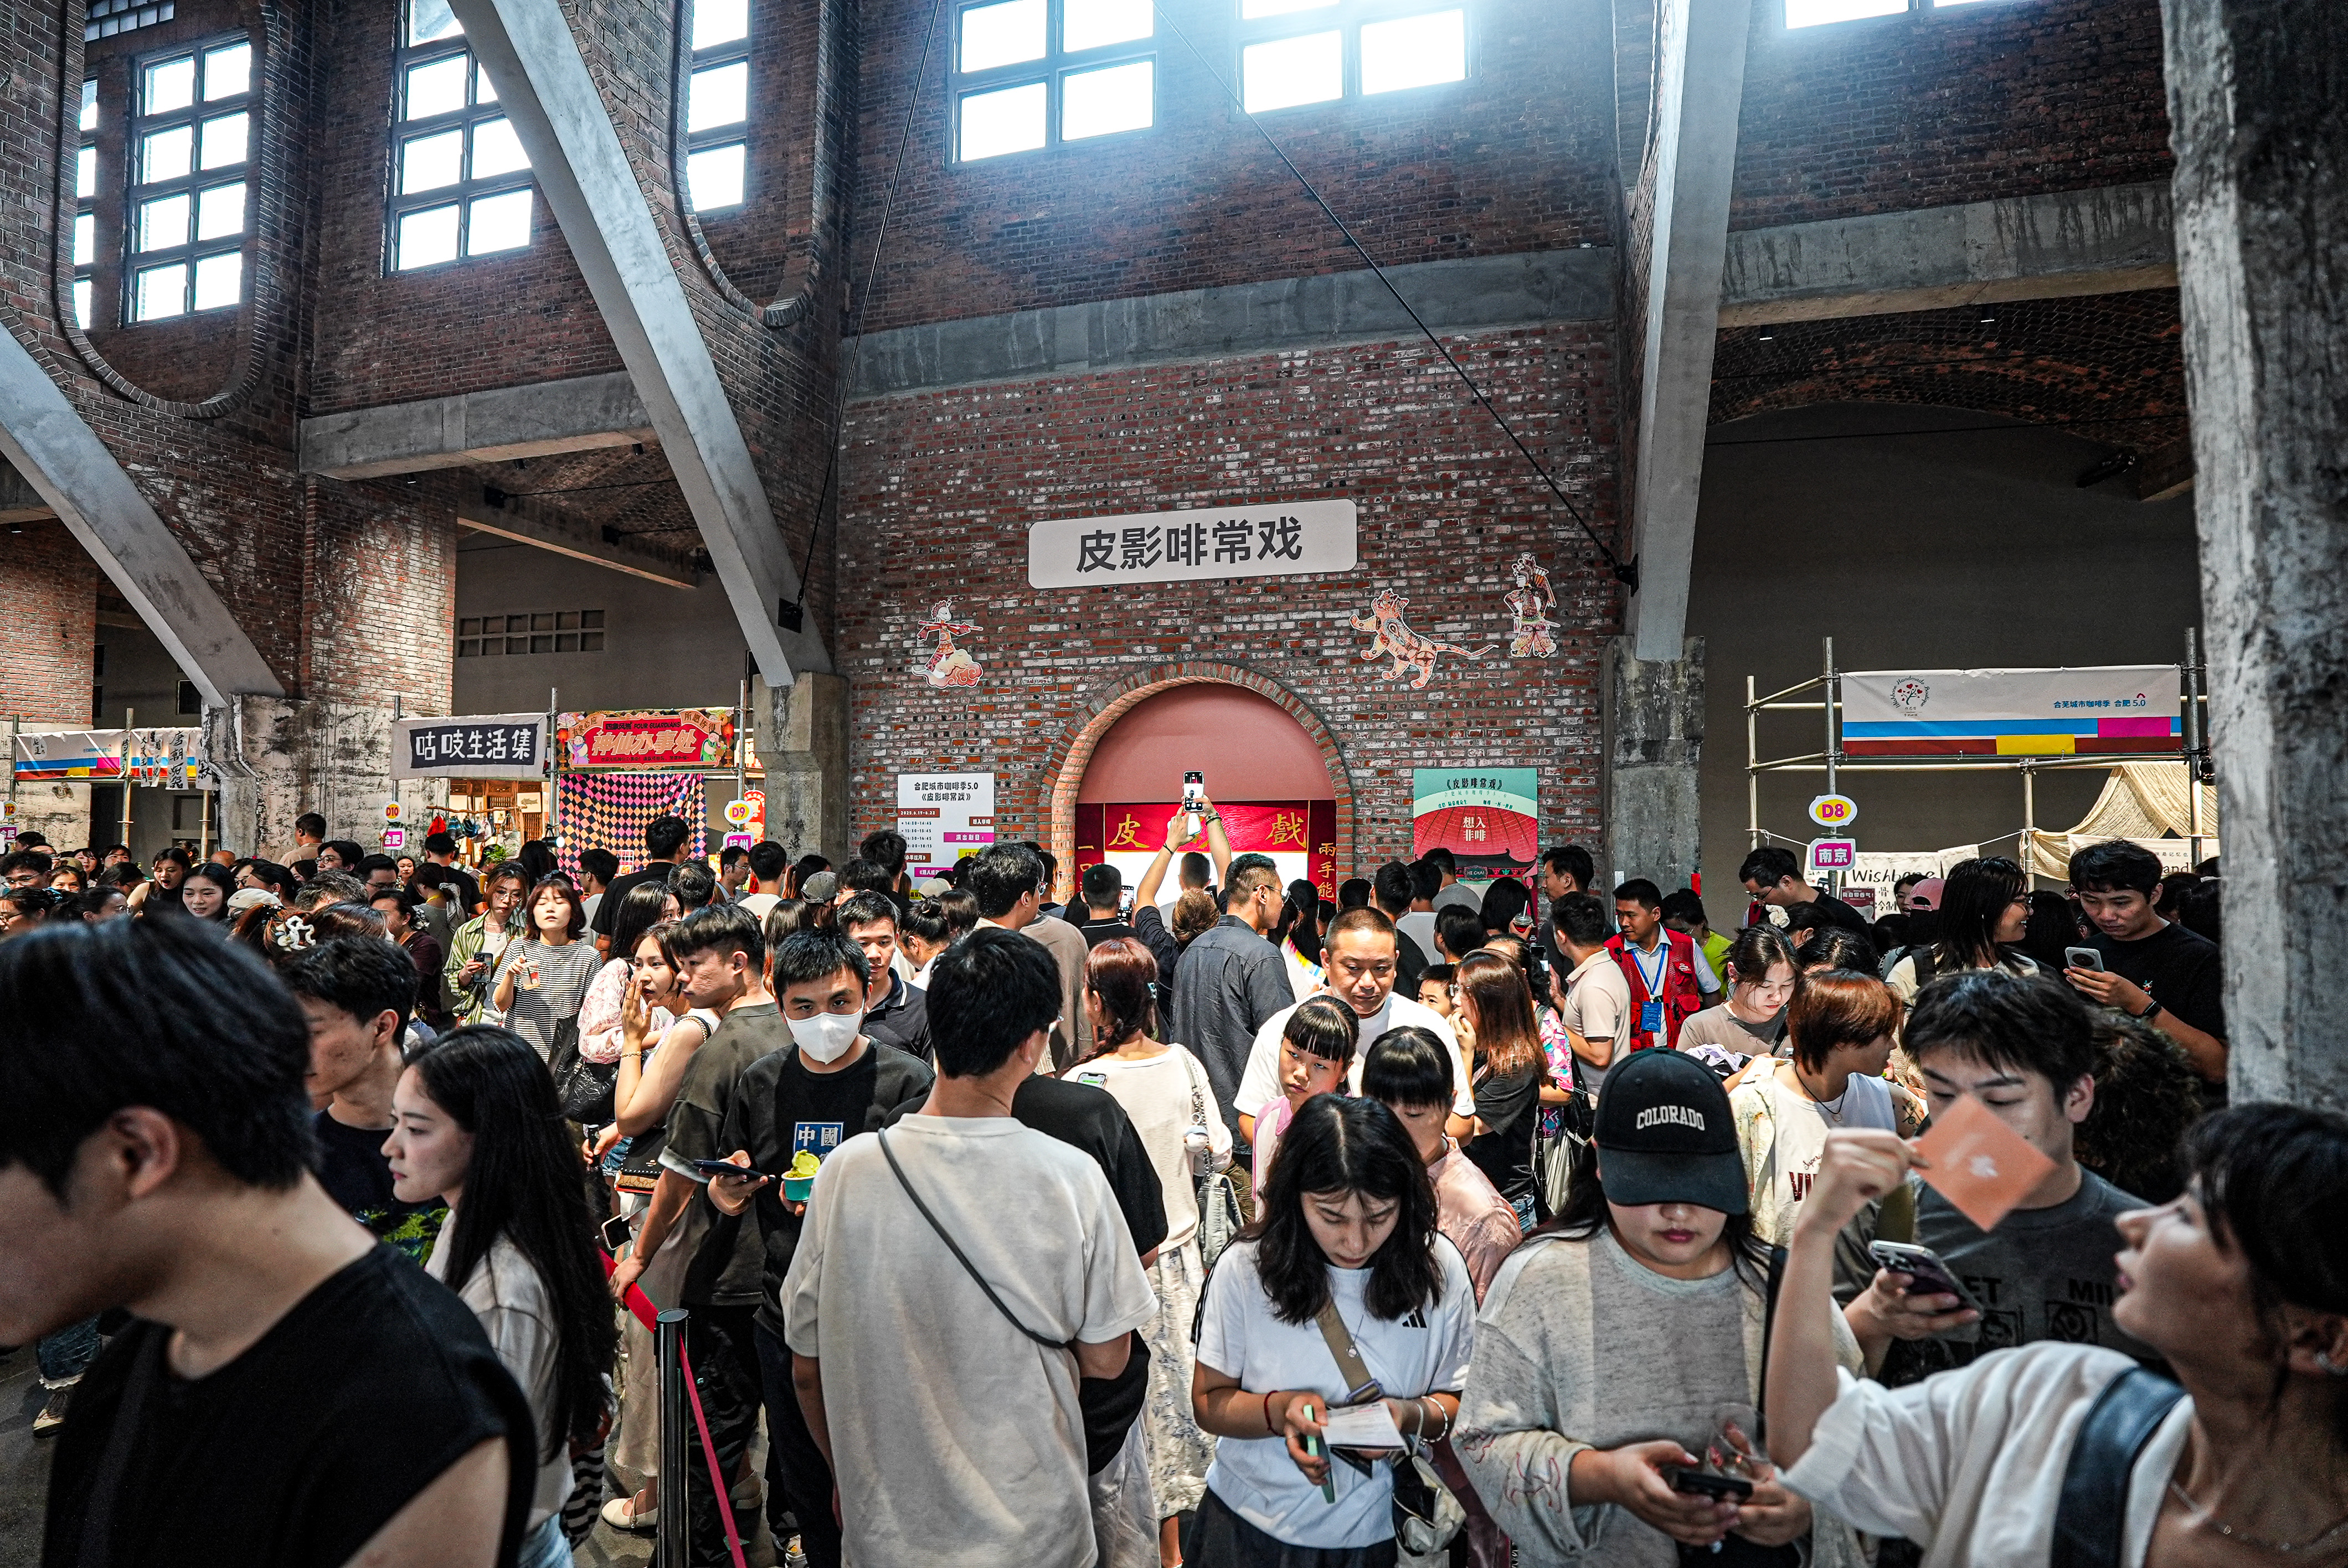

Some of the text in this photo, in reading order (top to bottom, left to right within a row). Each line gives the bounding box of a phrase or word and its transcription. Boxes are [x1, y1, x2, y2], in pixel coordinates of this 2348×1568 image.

[1076, 516, 1302, 573] 皮影啡常戏
[2053, 700, 2110, 708] 合芜城市咖啡季
[416, 728, 532, 761] 咕吱生活集
[592, 729, 697, 756] 神仙办事处
[914, 781, 979, 791] 合肥城市咖啡季5.0
[922, 793, 971, 801] 《皮影啡常戏》
[386, 807, 399, 817] D10
[732, 807, 745, 818] D9
[1822, 803, 1844, 818] D8
[1463, 816, 1486, 828] 想入
[384, 834, 401, 844] 合肥
[1819, 848, 1847, 863] 南京
[1318, 843, 1336, 898] 兩手能
[1636, 1105, 1705, 1131] COLORADO
[798, 1126, 838, 1147] 中國
